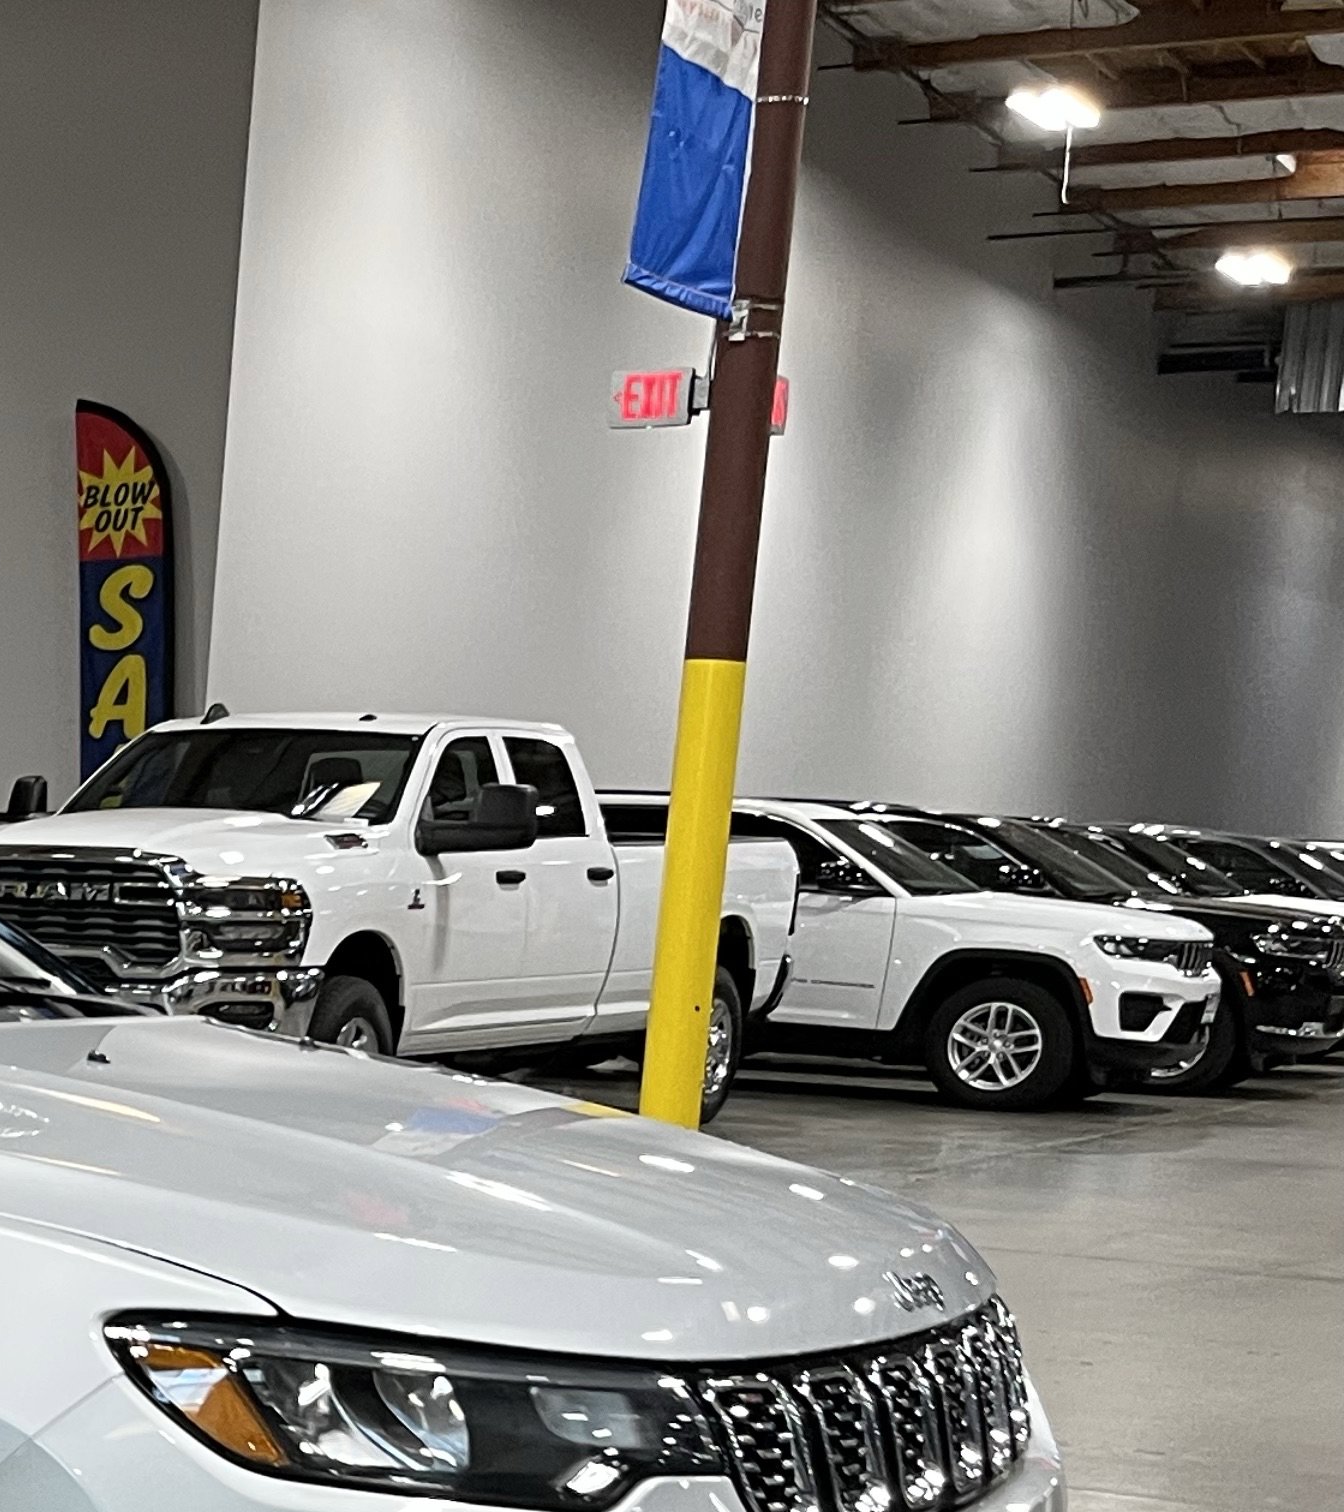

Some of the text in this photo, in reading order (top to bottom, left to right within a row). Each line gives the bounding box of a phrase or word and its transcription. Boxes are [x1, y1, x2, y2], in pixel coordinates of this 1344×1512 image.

[623, 371, 683, 421] EXIT
[82, 480, 155, 510] BLOW
[94, 505, 144, 533] OUT
[88, 563, 155, 742] SA
